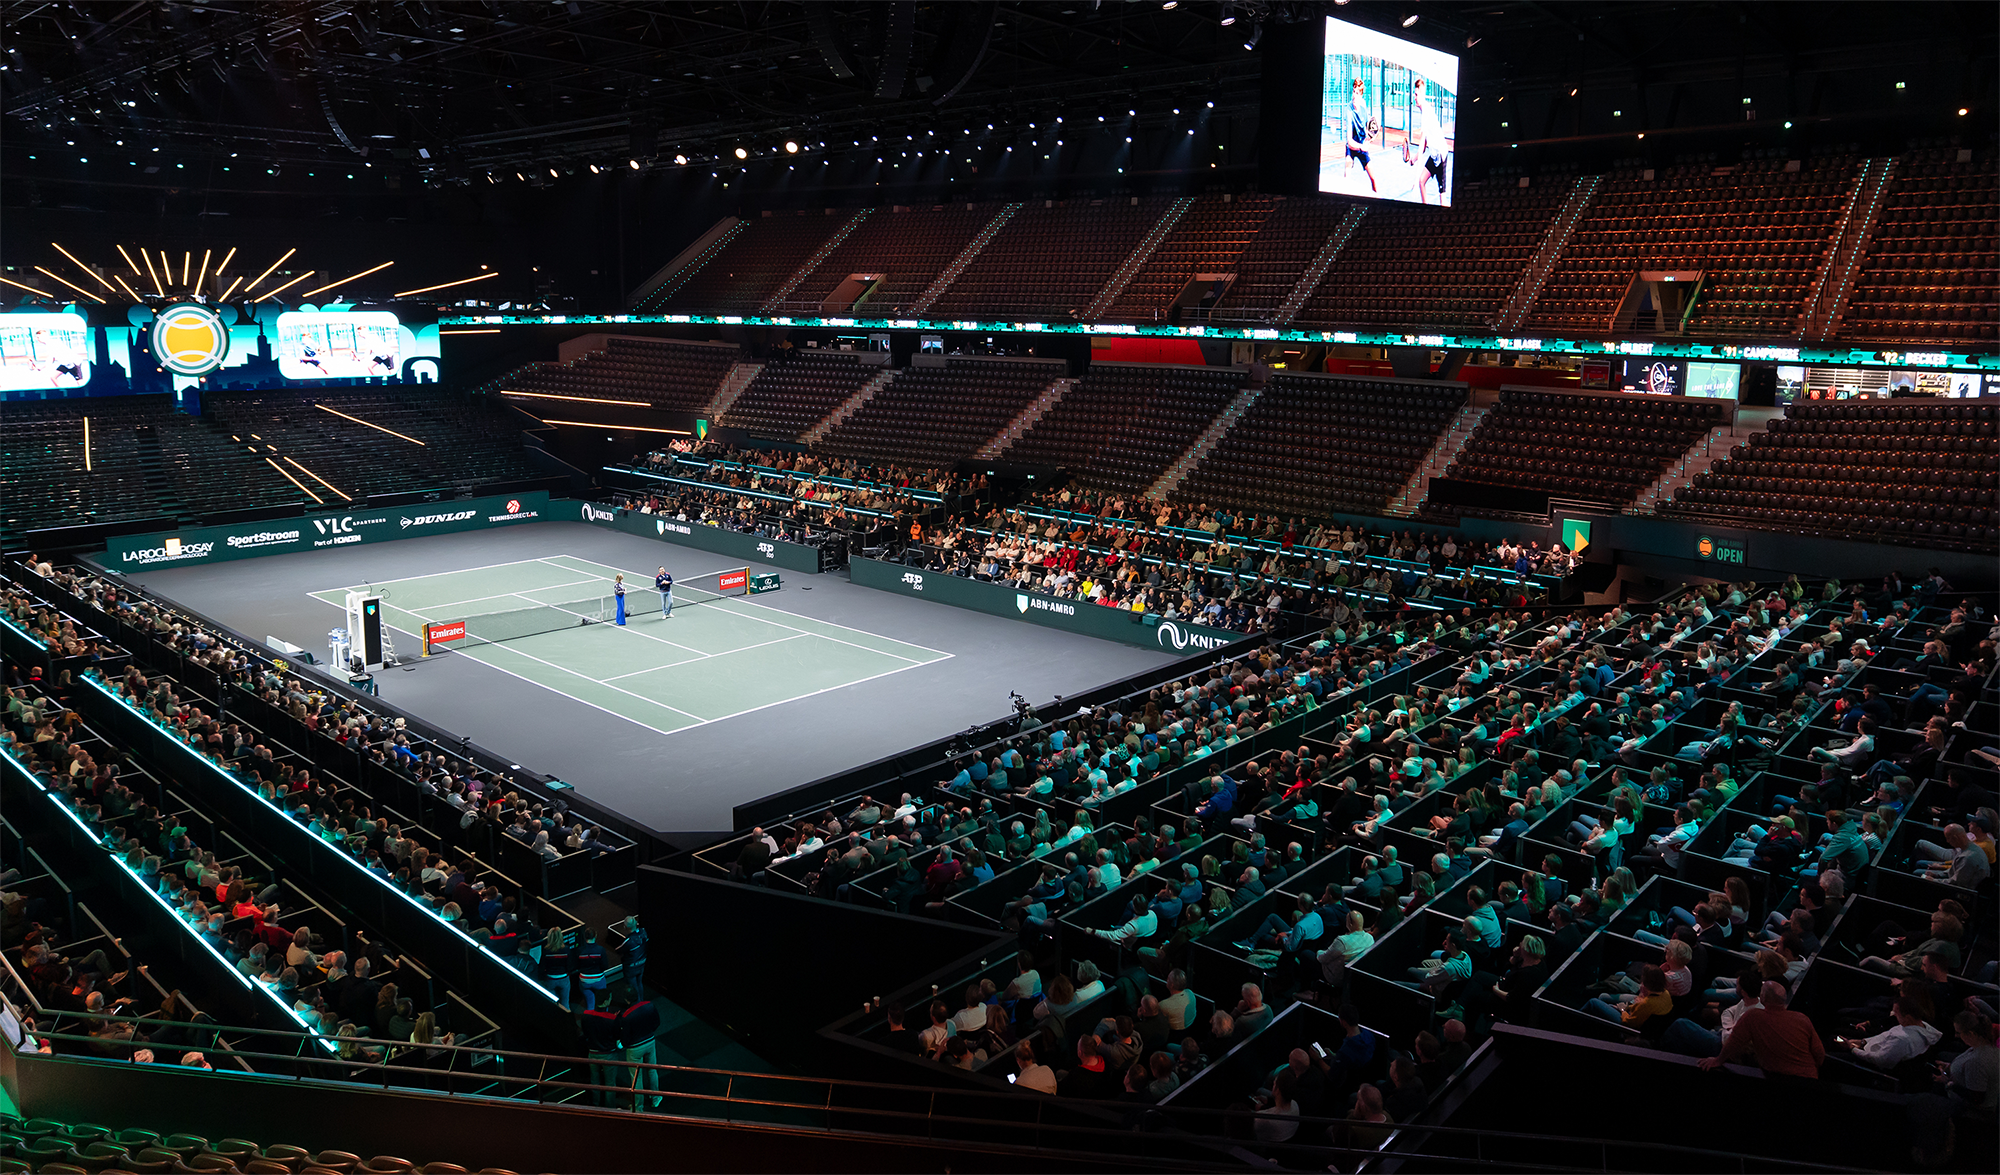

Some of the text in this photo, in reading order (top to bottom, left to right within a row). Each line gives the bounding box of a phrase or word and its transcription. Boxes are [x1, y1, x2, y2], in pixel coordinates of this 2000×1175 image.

[1620, 342, 1654, 353] GILBERT
[1723, 346, 1737, 357] '91
[1743, 347, 1800, 359] CAMPORESE
[1882, 351, 1898, 364] '92
[1905, 353, 1948, 365] BECKER
[412, 510, 477, 526] DUNLOP
[488, 511, 539, 523] TENNISDIRECT.NL
[595, 509, 614, 522] KNLTB
[313, 516, 353, 535] VLC
[227, 530, 300, 546] SportStroom
[1717, 547, 1743, 563] OPEN
[720, 576, 745, 586] Emirates
[901, 572, 923, 584] ATP
[430, 627, 464, 640] Emirates
